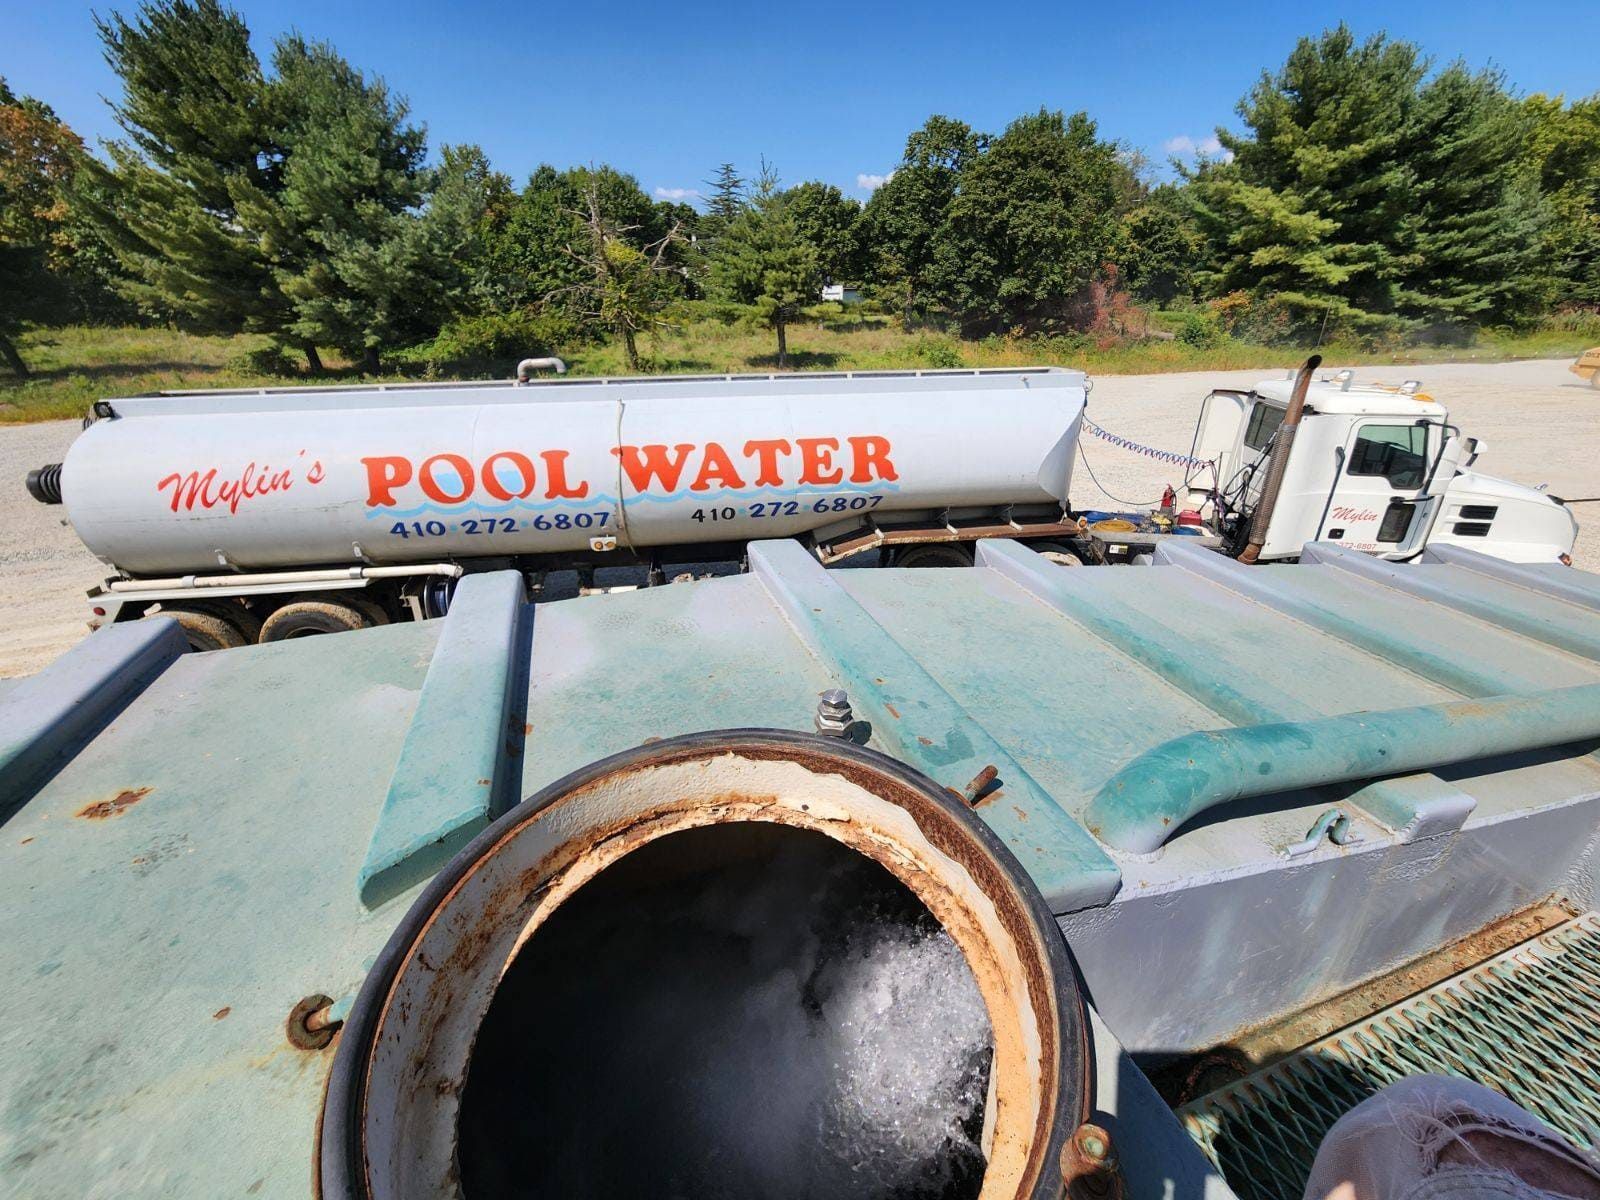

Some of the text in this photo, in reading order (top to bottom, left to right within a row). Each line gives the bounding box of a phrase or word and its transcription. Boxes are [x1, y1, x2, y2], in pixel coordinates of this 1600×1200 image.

[156, 449, 325, 515] Mylin's
[360, 435, 899, 507] POOL WATER
[1332, 506, 1378, 523] Mylin
